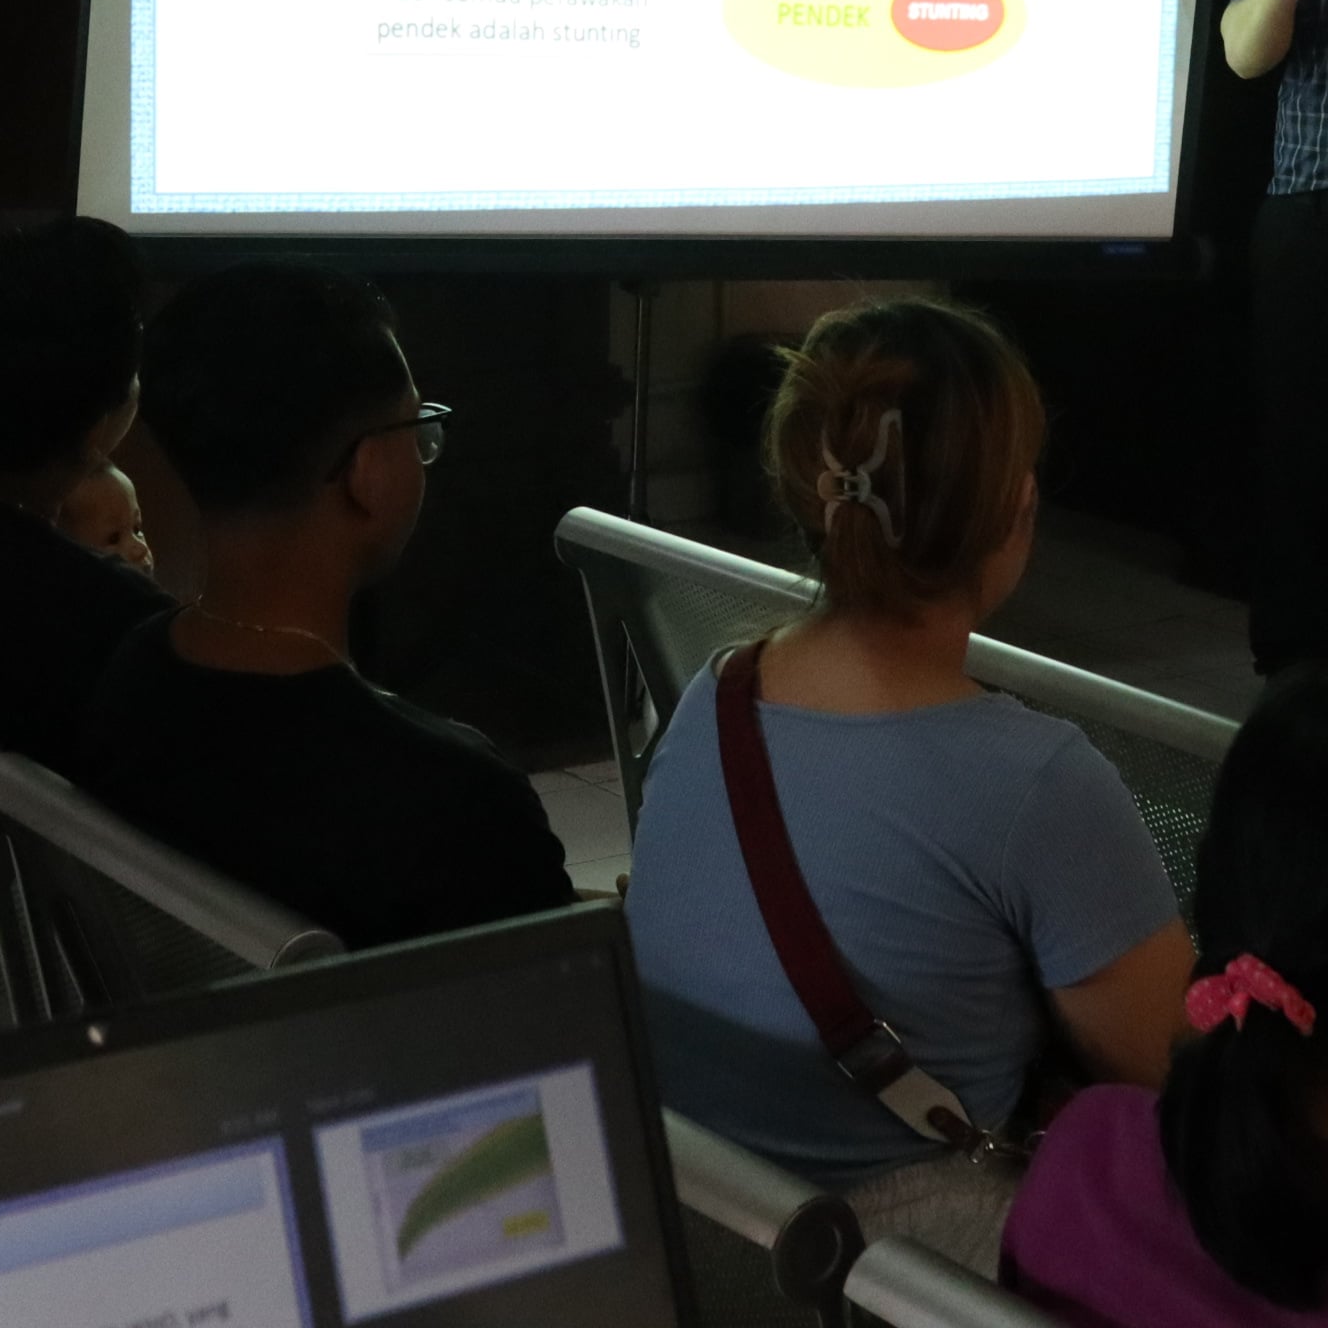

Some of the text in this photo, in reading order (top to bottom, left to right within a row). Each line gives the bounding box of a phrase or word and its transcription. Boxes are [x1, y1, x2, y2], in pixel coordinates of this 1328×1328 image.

[777, 2, 870, 27] PENDEK
[908, 2, 989, 20] STUNTING
[378, 16, 640, 49] pendek adalah stunting
